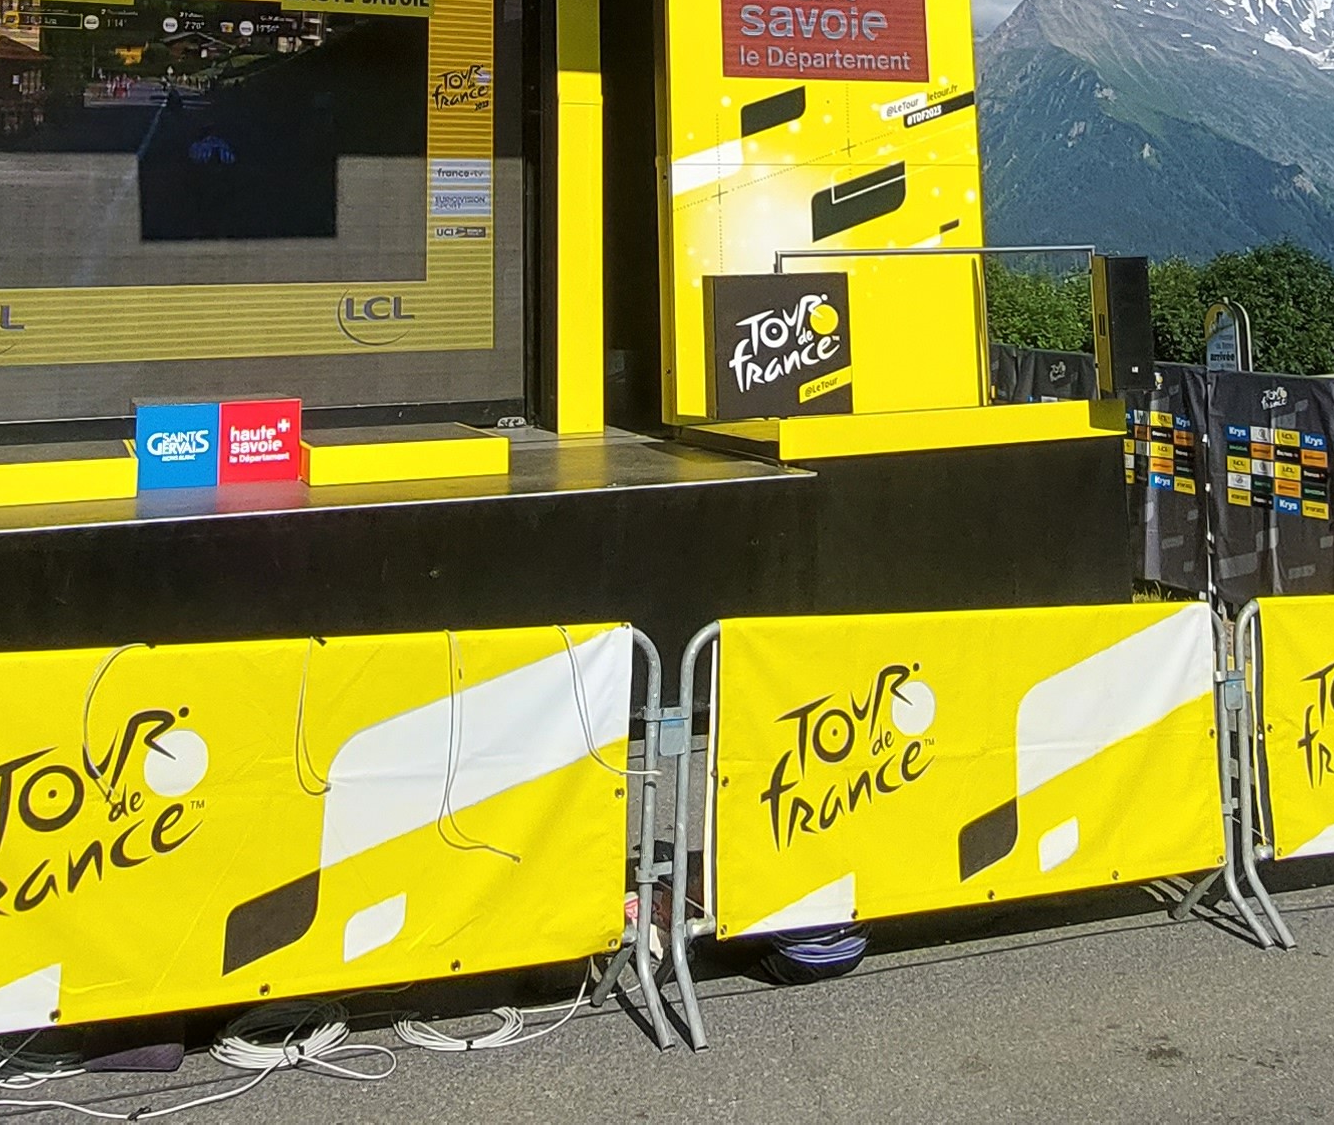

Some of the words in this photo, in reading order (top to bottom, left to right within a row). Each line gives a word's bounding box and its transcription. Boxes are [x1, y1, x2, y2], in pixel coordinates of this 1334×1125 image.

[740, 3, 889, 41] savoie
[740, 44, 760, 66] le
[768, 46, 911, 74] Département
[437, 64, 484, 92] TOUR
[432, 84, 489, 111] france
[927, 84, 958, 101] letour.fr
[886, 98, 919, 117] @LeTour
[436, 227, 454, 237] UCI
[346, 296, 415, 321] LCL
[735, 294, 828, 356] TOUR
[797, 327, 814, 345] de
[729, 336, 840, 393] france
[805, 377, 838, 397] @LeTour
[230, 425, 276, 442] haute
[1229, 427, 1246, 437] Krys
[1305, 435, 1323, 446] Krys
[230, 440, 282, 454] savoie
[1279, 499, 1298, 510] Krys
[774, 661, 922, 778] TOUR
[871, 726, 894, 757] de
[108, 787, 144, 820] de
[761, 737, 934, 852] france
